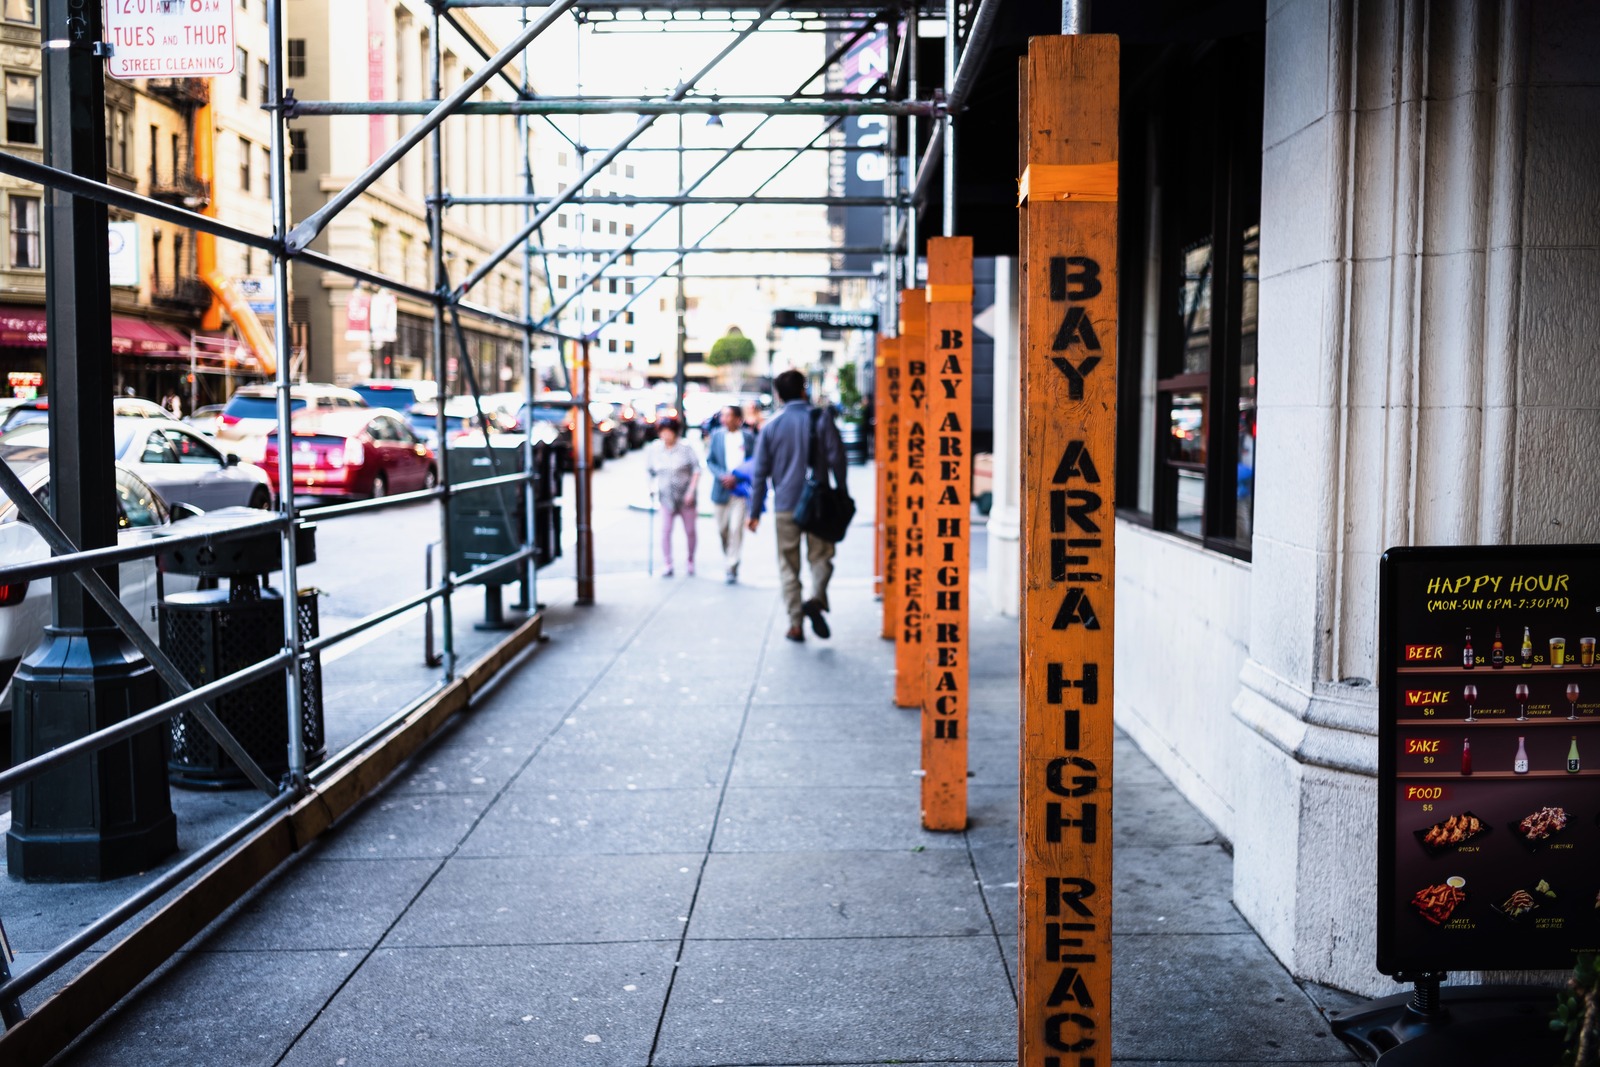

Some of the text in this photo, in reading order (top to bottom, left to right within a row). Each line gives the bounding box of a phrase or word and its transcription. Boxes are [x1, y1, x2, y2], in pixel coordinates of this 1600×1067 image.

[114, 25, 227, 46] TUES AND THUR
[122, 56, 224, 72] STREET CLEANING
[904, 360, 926, 644] BAY AREA HIGH REACH
[934, 329, 964, 739] BAY AREA HIGH REACH
[1427, 574, 1570, 594] HAPPY HOUR
[1427, 597, 1570, 613] (MON-SUN 6PM-7:30PM)
[1409, 646, 1443, 659] BEER
[1045, 256, 1102, 1067] BAY AREA HIGH REAC
[1408, 691, 1450, 704] WINE
[1424, 708, 1435, 716] $6
[1409, 740, 1440, 753] SAKE
[1424, 756, 1434, 764] $9
[1408, 787, 1442, 799] FOOD
[1423, 804, 1433, 812] $5
